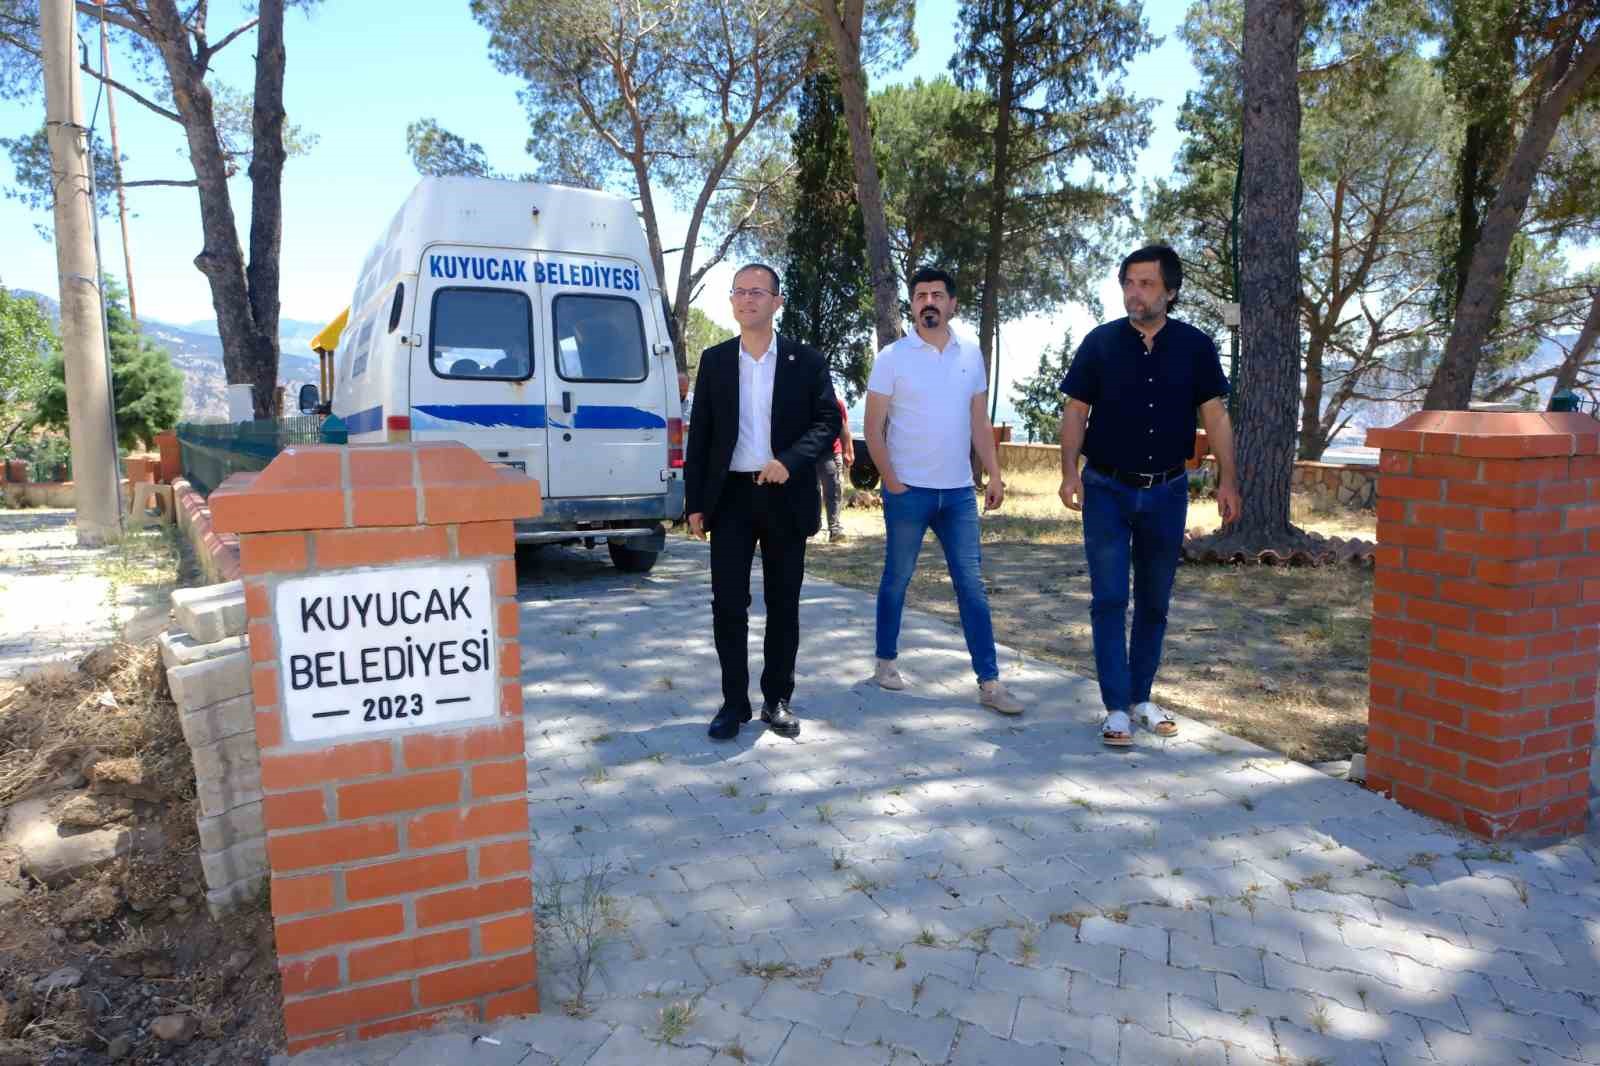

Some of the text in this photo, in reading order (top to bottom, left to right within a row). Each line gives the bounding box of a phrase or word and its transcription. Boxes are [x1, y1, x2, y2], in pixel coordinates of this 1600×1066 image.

[430, 254, 641, 291] KUYUCAK BELEDİYESİ
[300, 586, 472, 633] KUYUCAK
[290, 628, 490, 690] BELEDİYESİ
[363, 693, 424, 722] 2023
